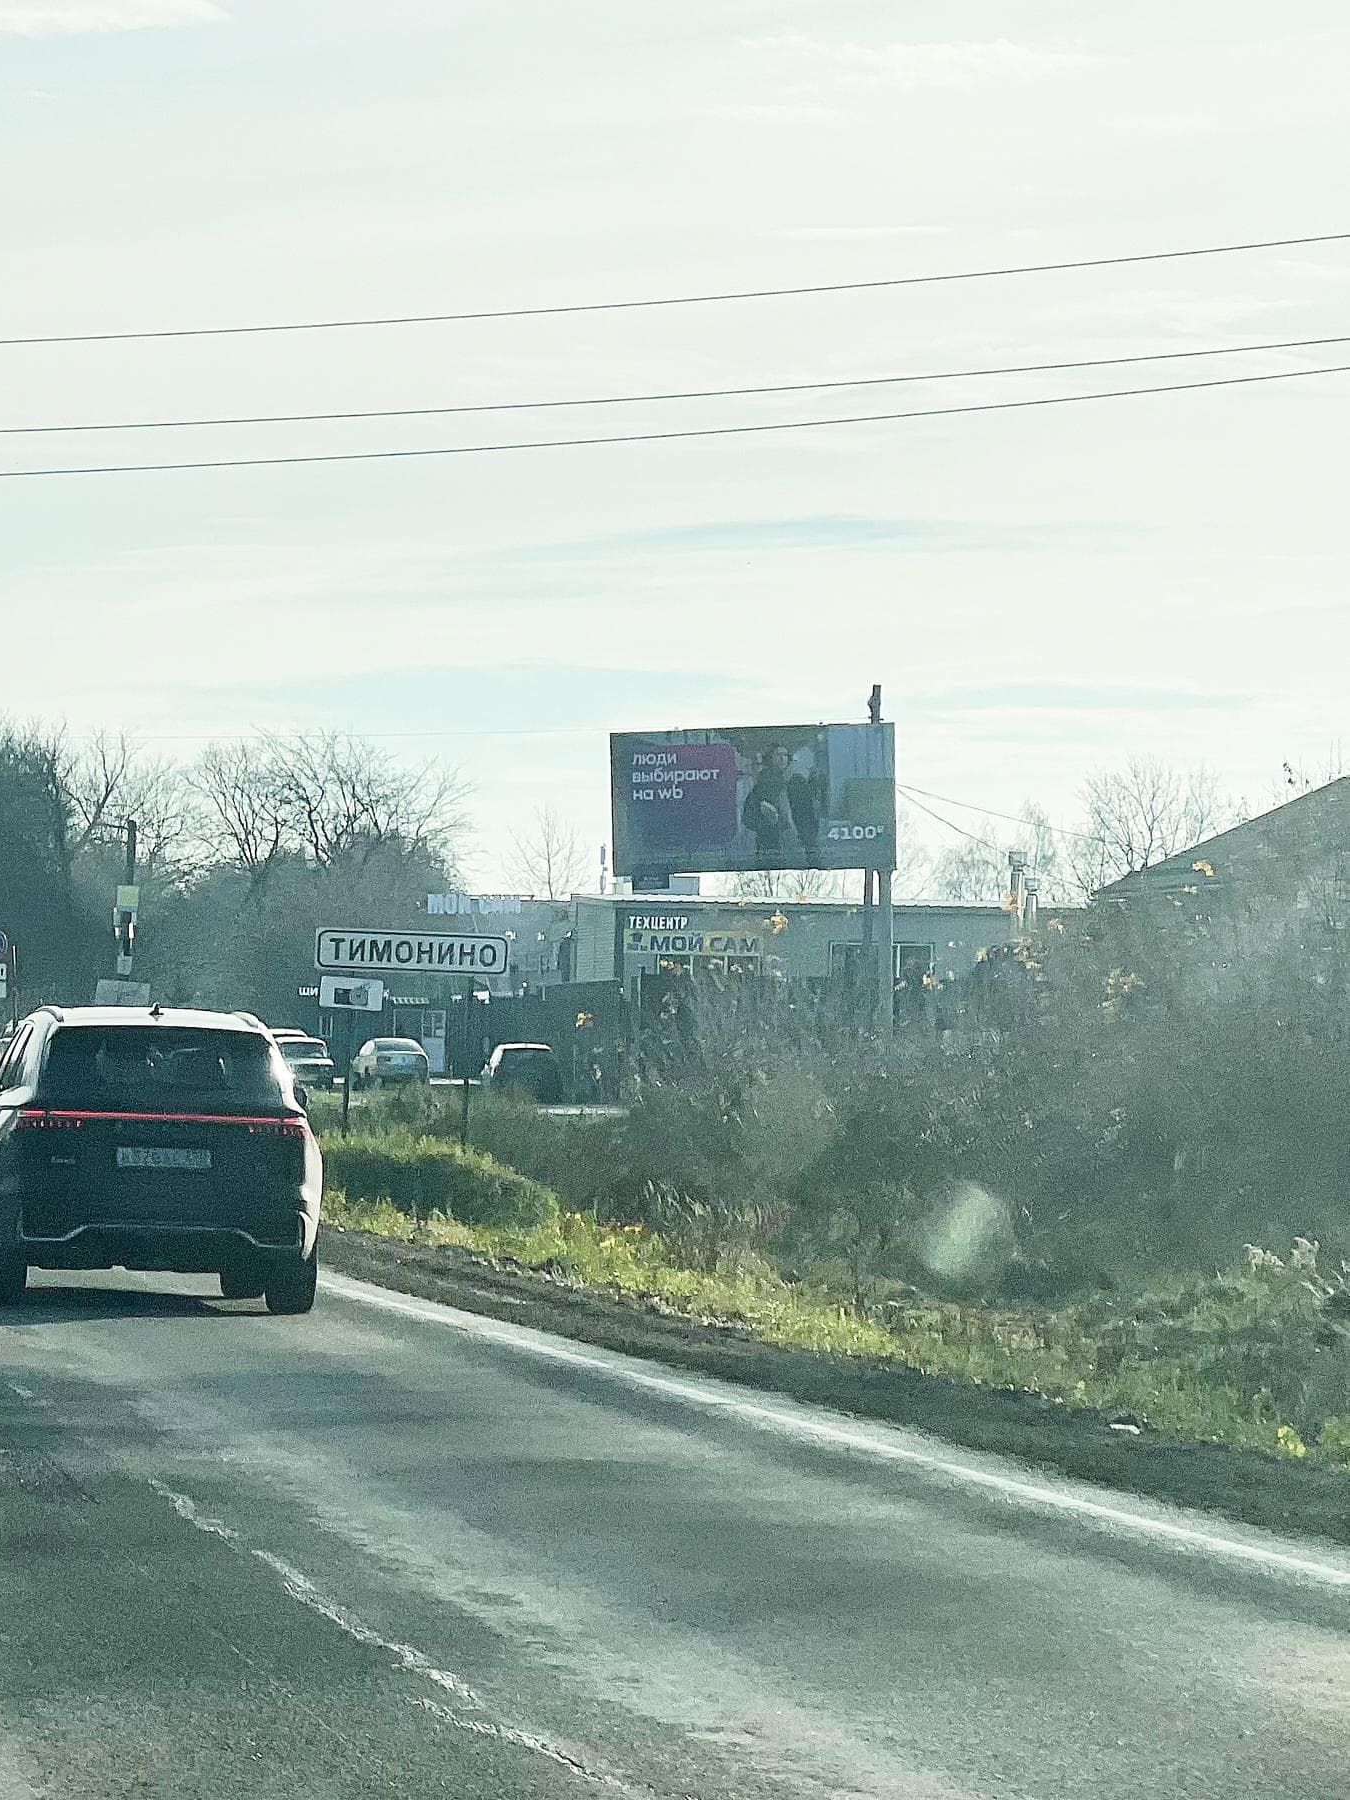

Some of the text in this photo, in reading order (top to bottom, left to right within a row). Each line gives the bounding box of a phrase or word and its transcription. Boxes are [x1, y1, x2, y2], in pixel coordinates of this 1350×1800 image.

[632, 753, 677, 766] люди
[632, 767, 720, 785] выбирают
[632, 784, 684, 800] на wb
[629, 915, 688, 930] ТЕХЦЕНТР
[329, 937, 497, 967] ТИМОНИНО
